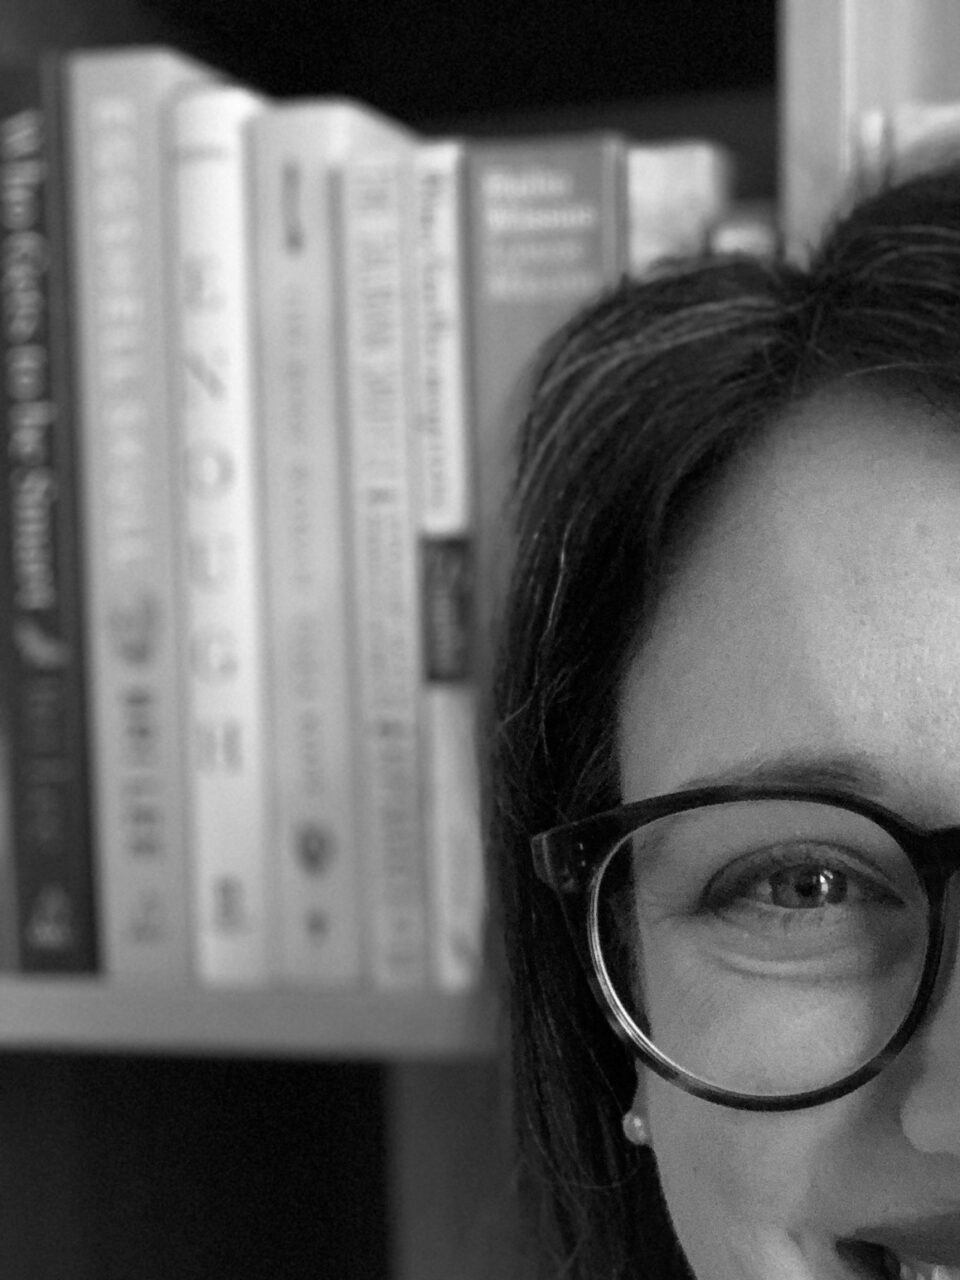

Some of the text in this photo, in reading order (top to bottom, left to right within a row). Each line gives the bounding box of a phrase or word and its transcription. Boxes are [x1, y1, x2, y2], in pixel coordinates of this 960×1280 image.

[2, 108, 59, 609] Who Gets to be Smart
[92, 100, 155, 565] EGGSHELL SKULL
